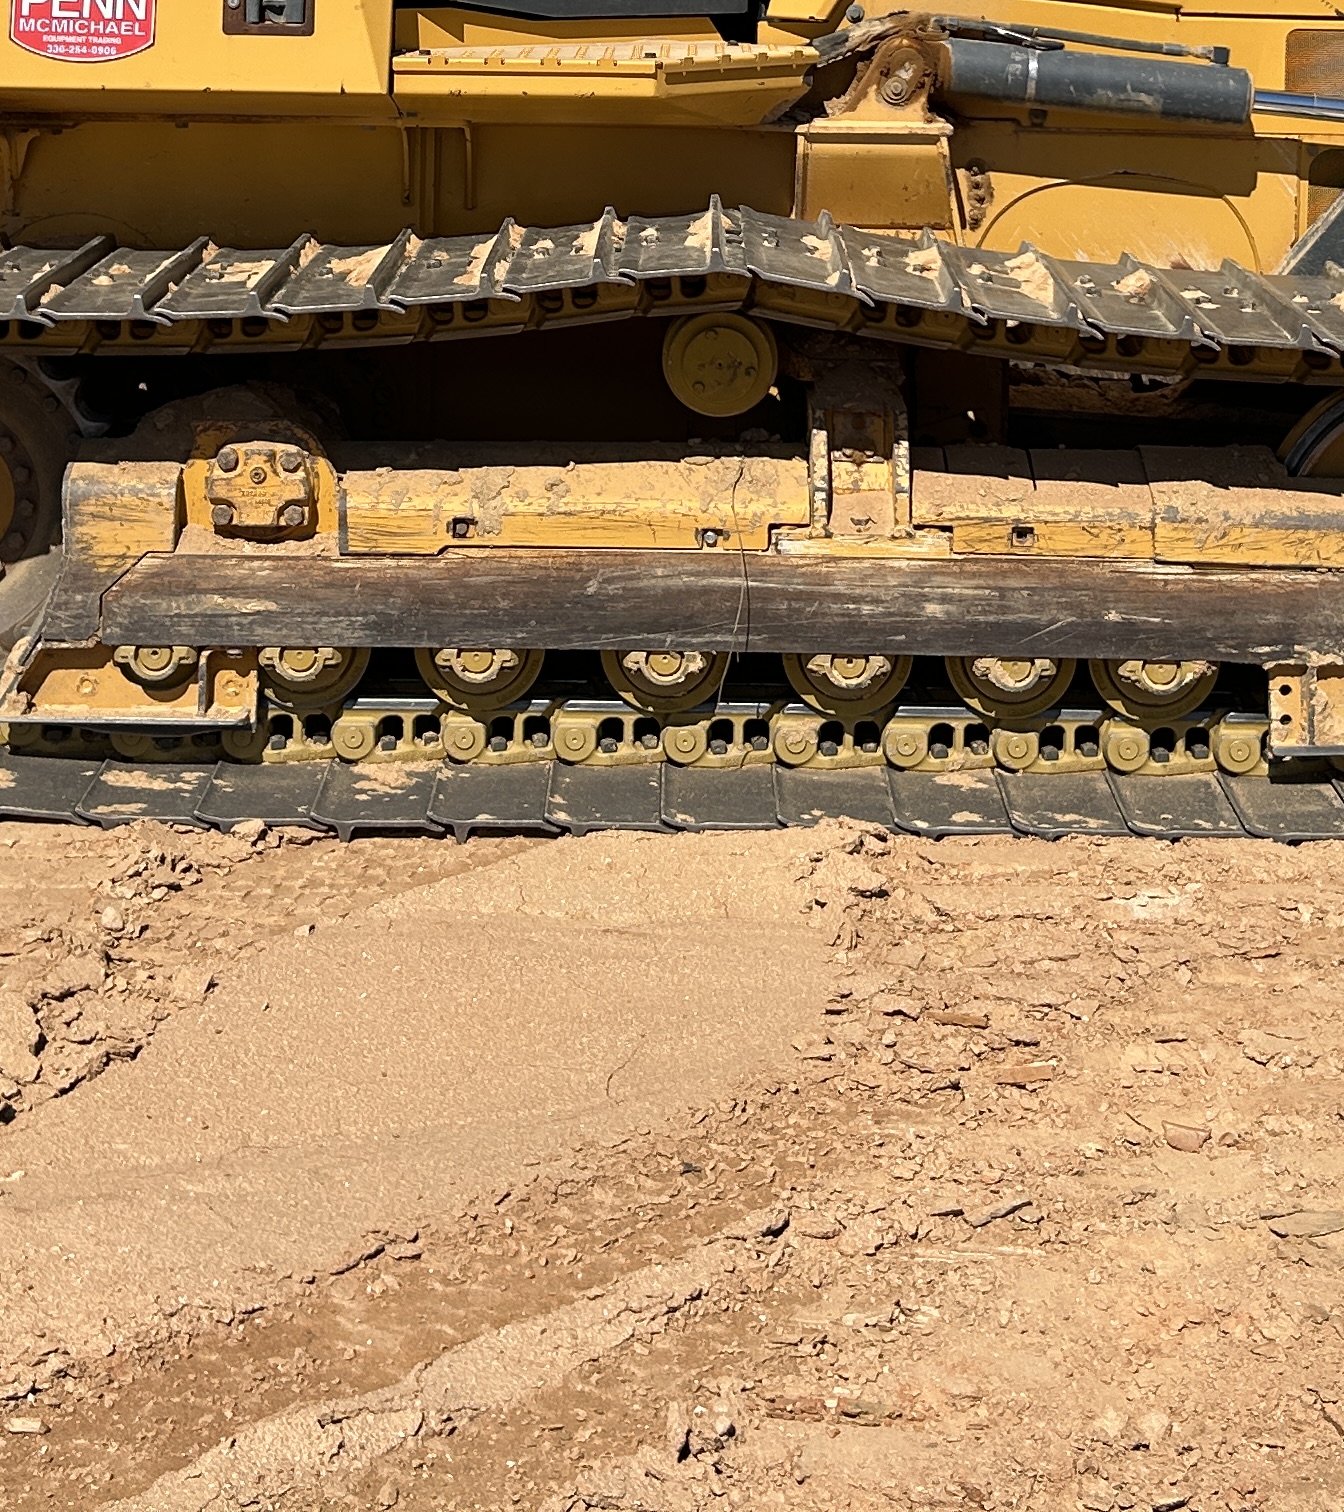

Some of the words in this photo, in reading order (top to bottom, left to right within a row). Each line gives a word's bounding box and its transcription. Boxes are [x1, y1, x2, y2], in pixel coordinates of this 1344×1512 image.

[19, 17, 146, 36] MCMICHAEL
[42, 34, 87, 43] EQUIPMENT
[88, 36, 122, 45] TRADING
